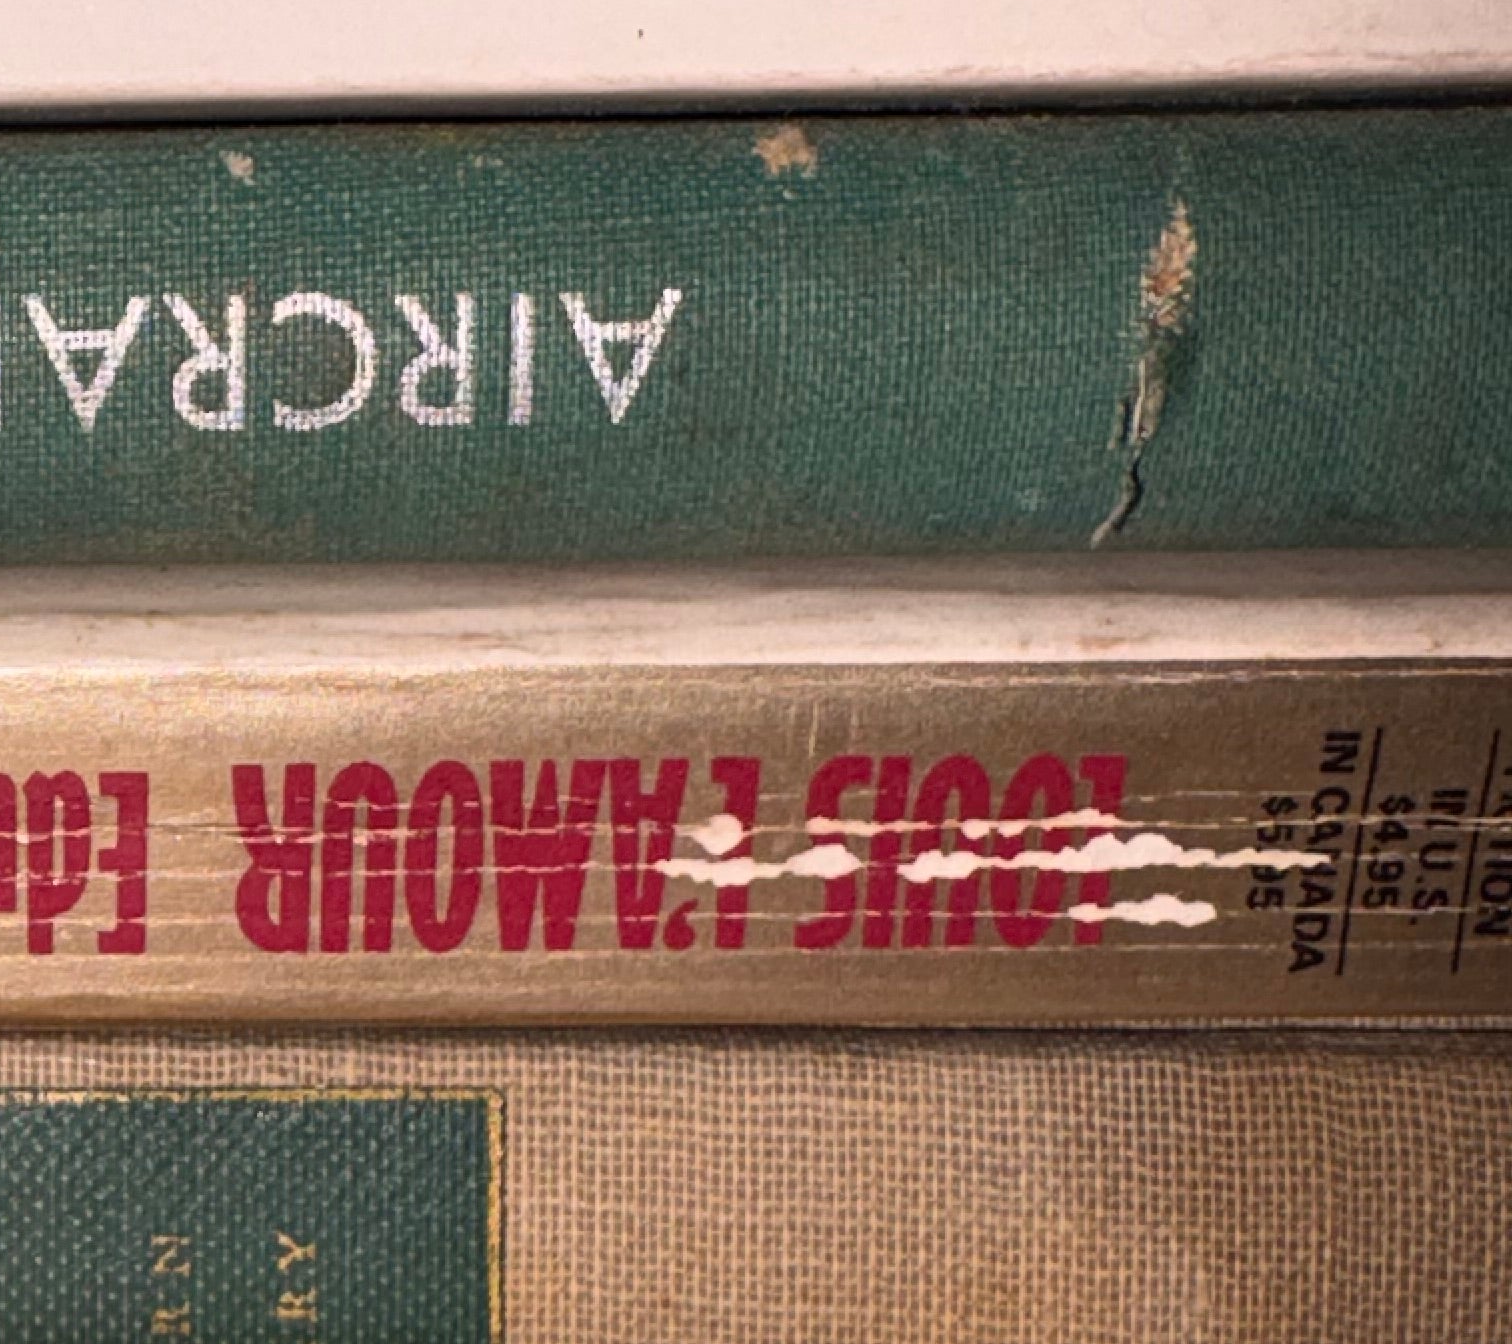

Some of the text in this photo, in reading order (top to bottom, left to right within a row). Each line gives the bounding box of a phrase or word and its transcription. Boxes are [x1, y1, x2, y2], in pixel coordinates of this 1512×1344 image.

[794, 753, 1127, 950] LOUIS
[1288, 730, 1362, 974] IN CANADA
[1362, 793, 1416, 910] $4.95
